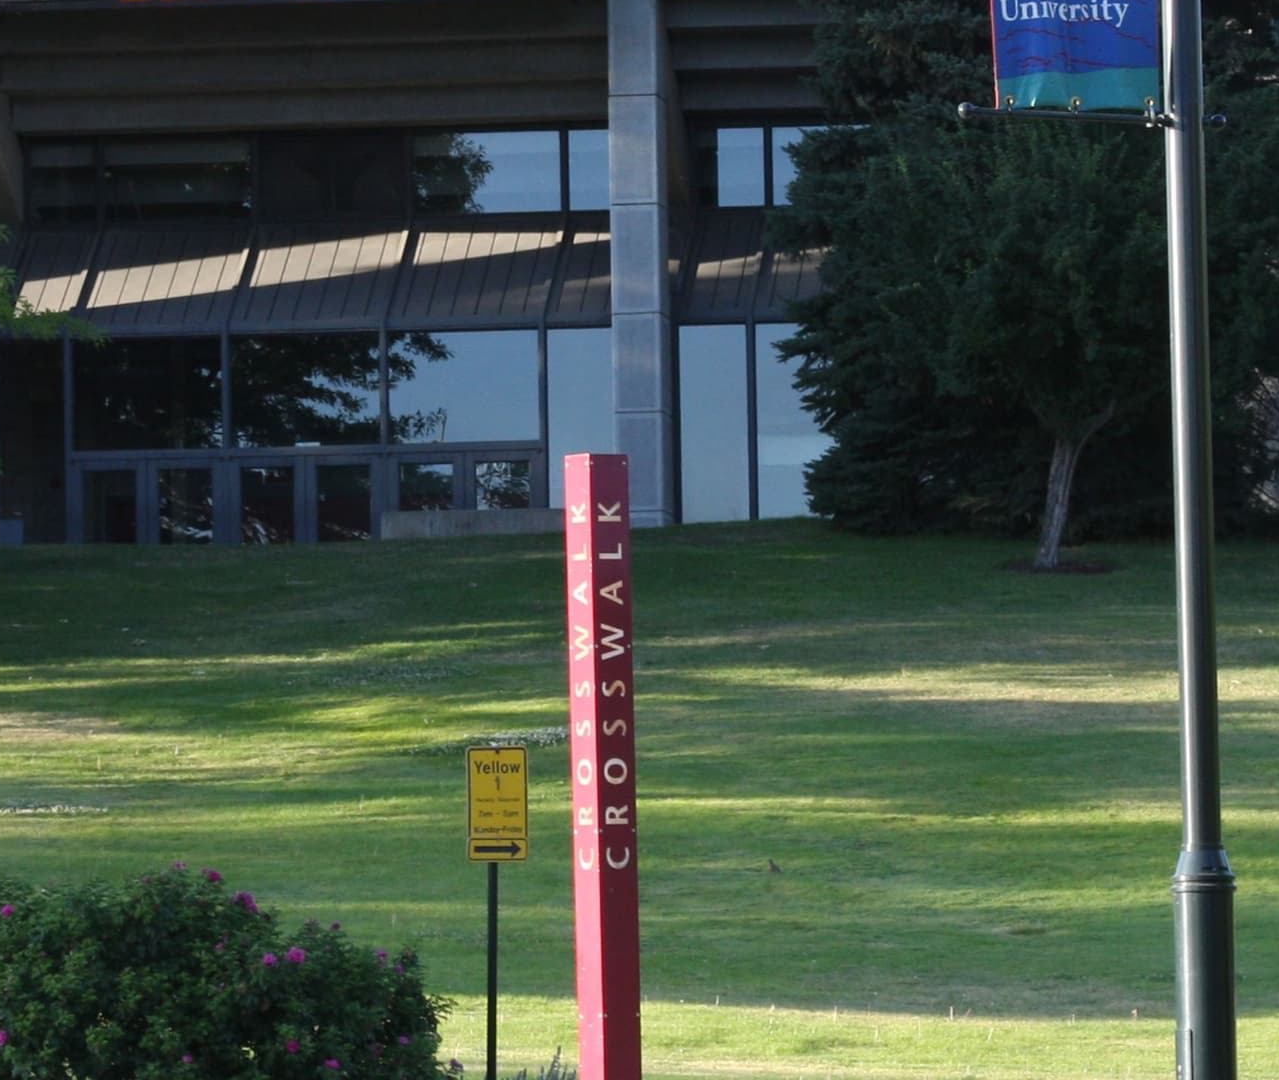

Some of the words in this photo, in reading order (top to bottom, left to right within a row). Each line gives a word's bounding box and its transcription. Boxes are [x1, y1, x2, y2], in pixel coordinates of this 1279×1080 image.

[474, 760, 521, 775] Yellow
[570, 503, 595, 870] CROSSWALK
[597, 501, 630, 869] CROSSWALK
